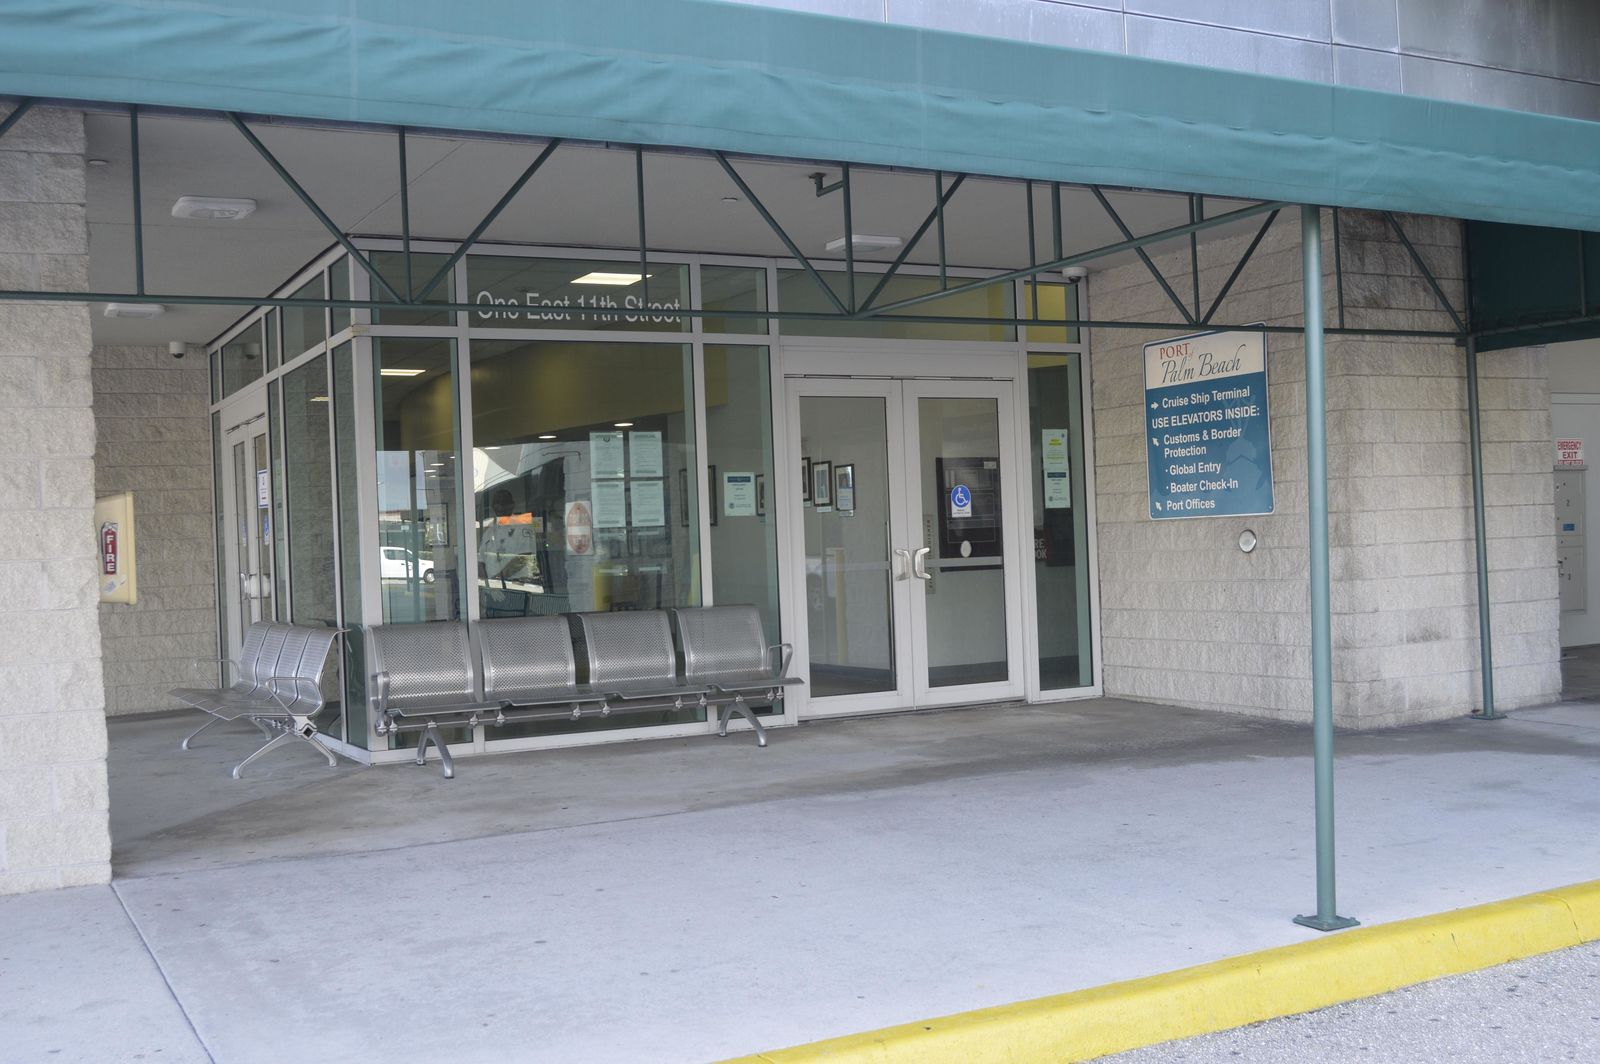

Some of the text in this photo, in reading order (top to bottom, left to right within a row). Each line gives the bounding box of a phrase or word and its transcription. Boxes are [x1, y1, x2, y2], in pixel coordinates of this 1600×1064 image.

[477, 291, 681, 322] One East 11th Street
[1159, 343, 1190, 359] PORT
[1162, 344, 1247, 384] Palm Beach
[1162, 386, 1250, 409] Cruise Ship Terminal
[1152, 405, 1260, 429] USE ELEVATORS INSIDE:
[1164, 427, 1242, 445] Customs & Border
[1164, 445, 1207, 458] Protection
[1562, 451, 1578, 459] EXIT
[1170, 462, 1221, 475] Global Entry
[1171, 478, 1239, 493] Boater Check-In
[1166, 498, 1215, 511] Port Offices
[106, 535, 115, 572] FIRE
